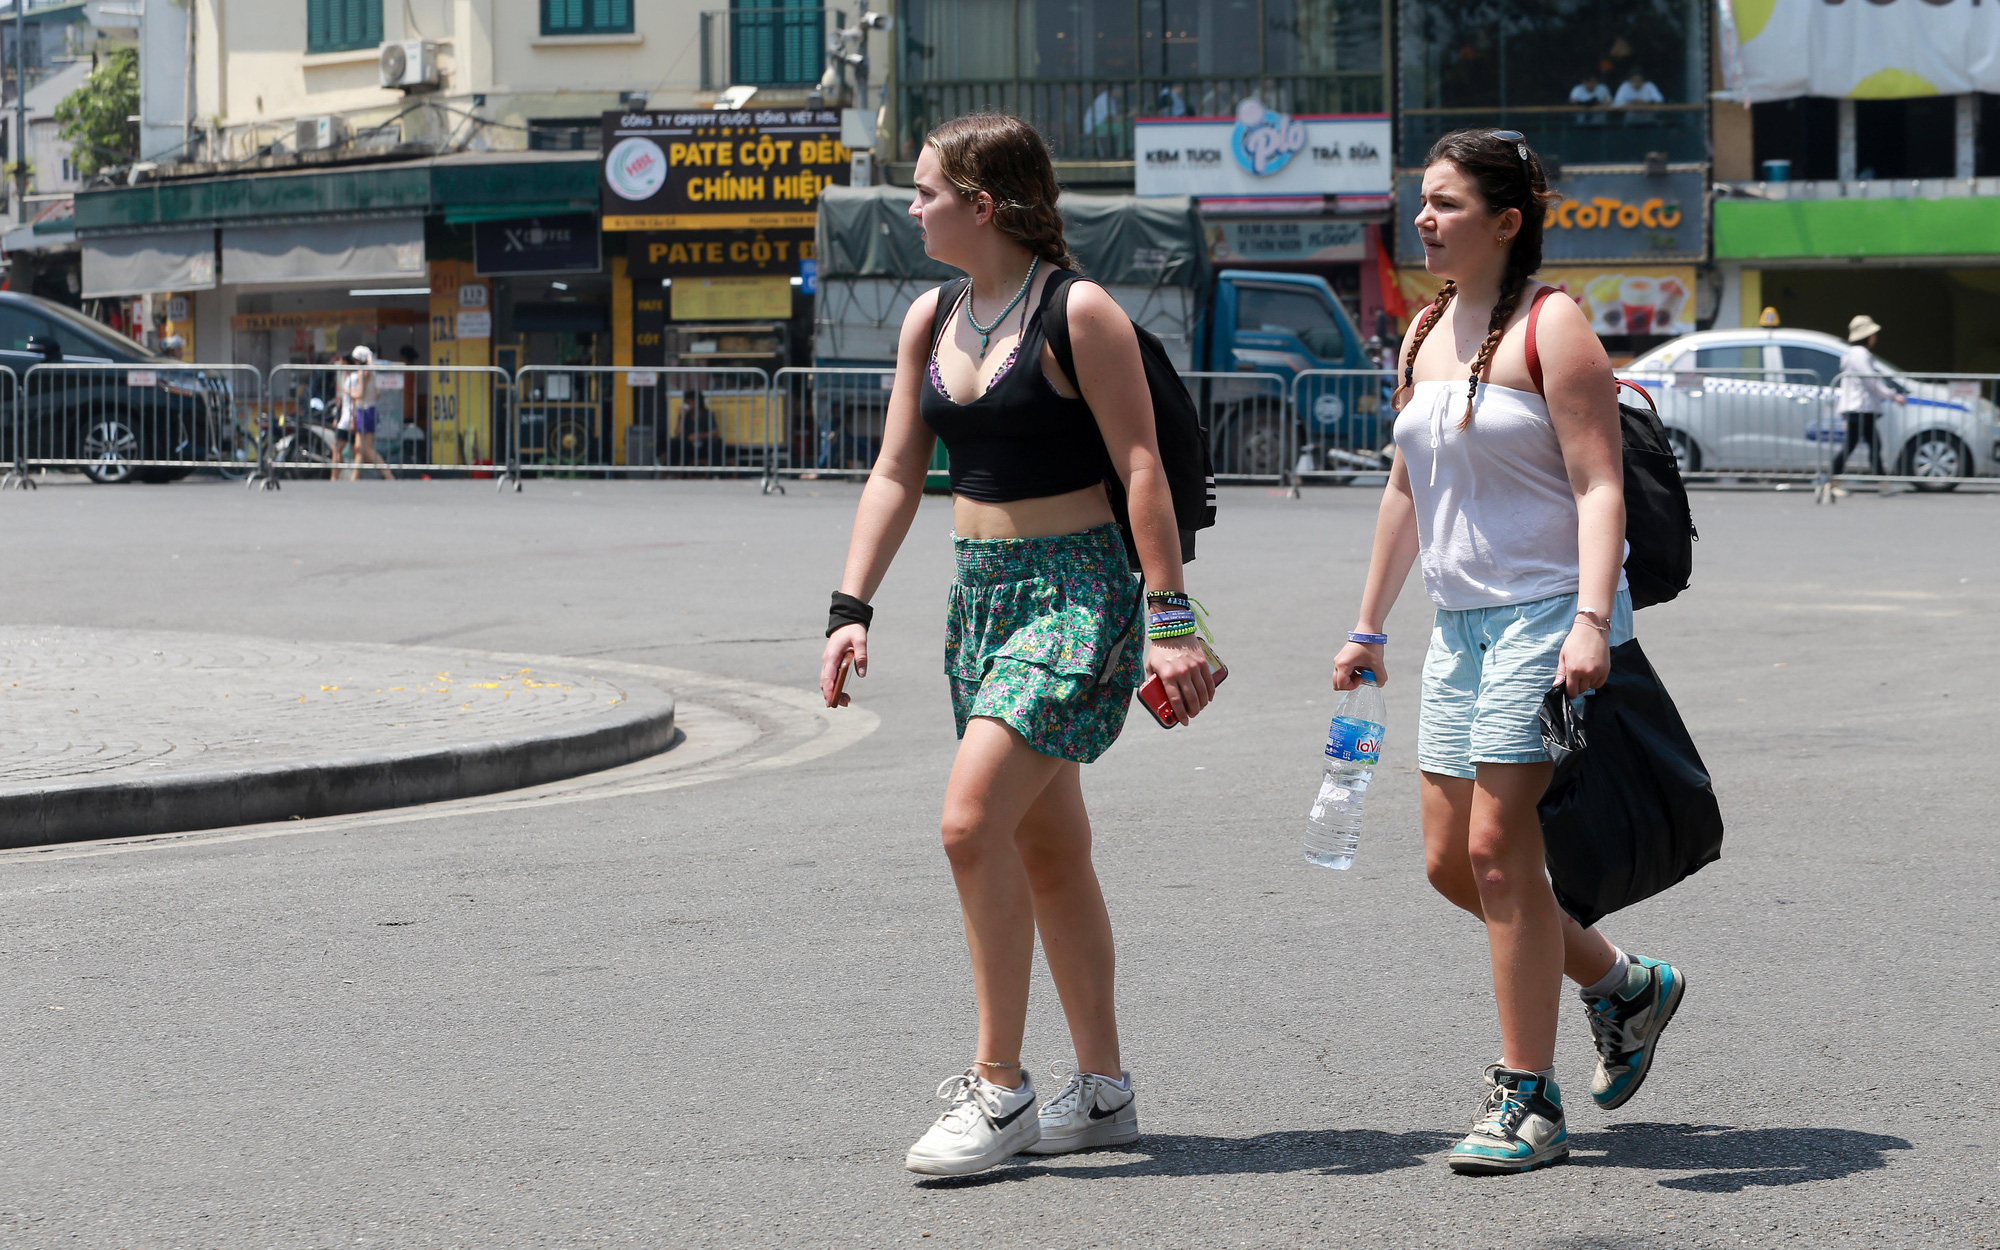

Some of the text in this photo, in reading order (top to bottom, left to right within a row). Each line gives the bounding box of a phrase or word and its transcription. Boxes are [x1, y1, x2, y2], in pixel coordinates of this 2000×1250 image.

[657, 115, 672, 126] TY
[670, 141, 733, 167] PATE
[739, 133, 792, 171] CỘT
[1146, 149, 1179, 163] KEM
[687, 170, 765, 202] CHÍNH
[649, 241, 724, 264] PATE
[729, 232, 791, 268] CỘT
